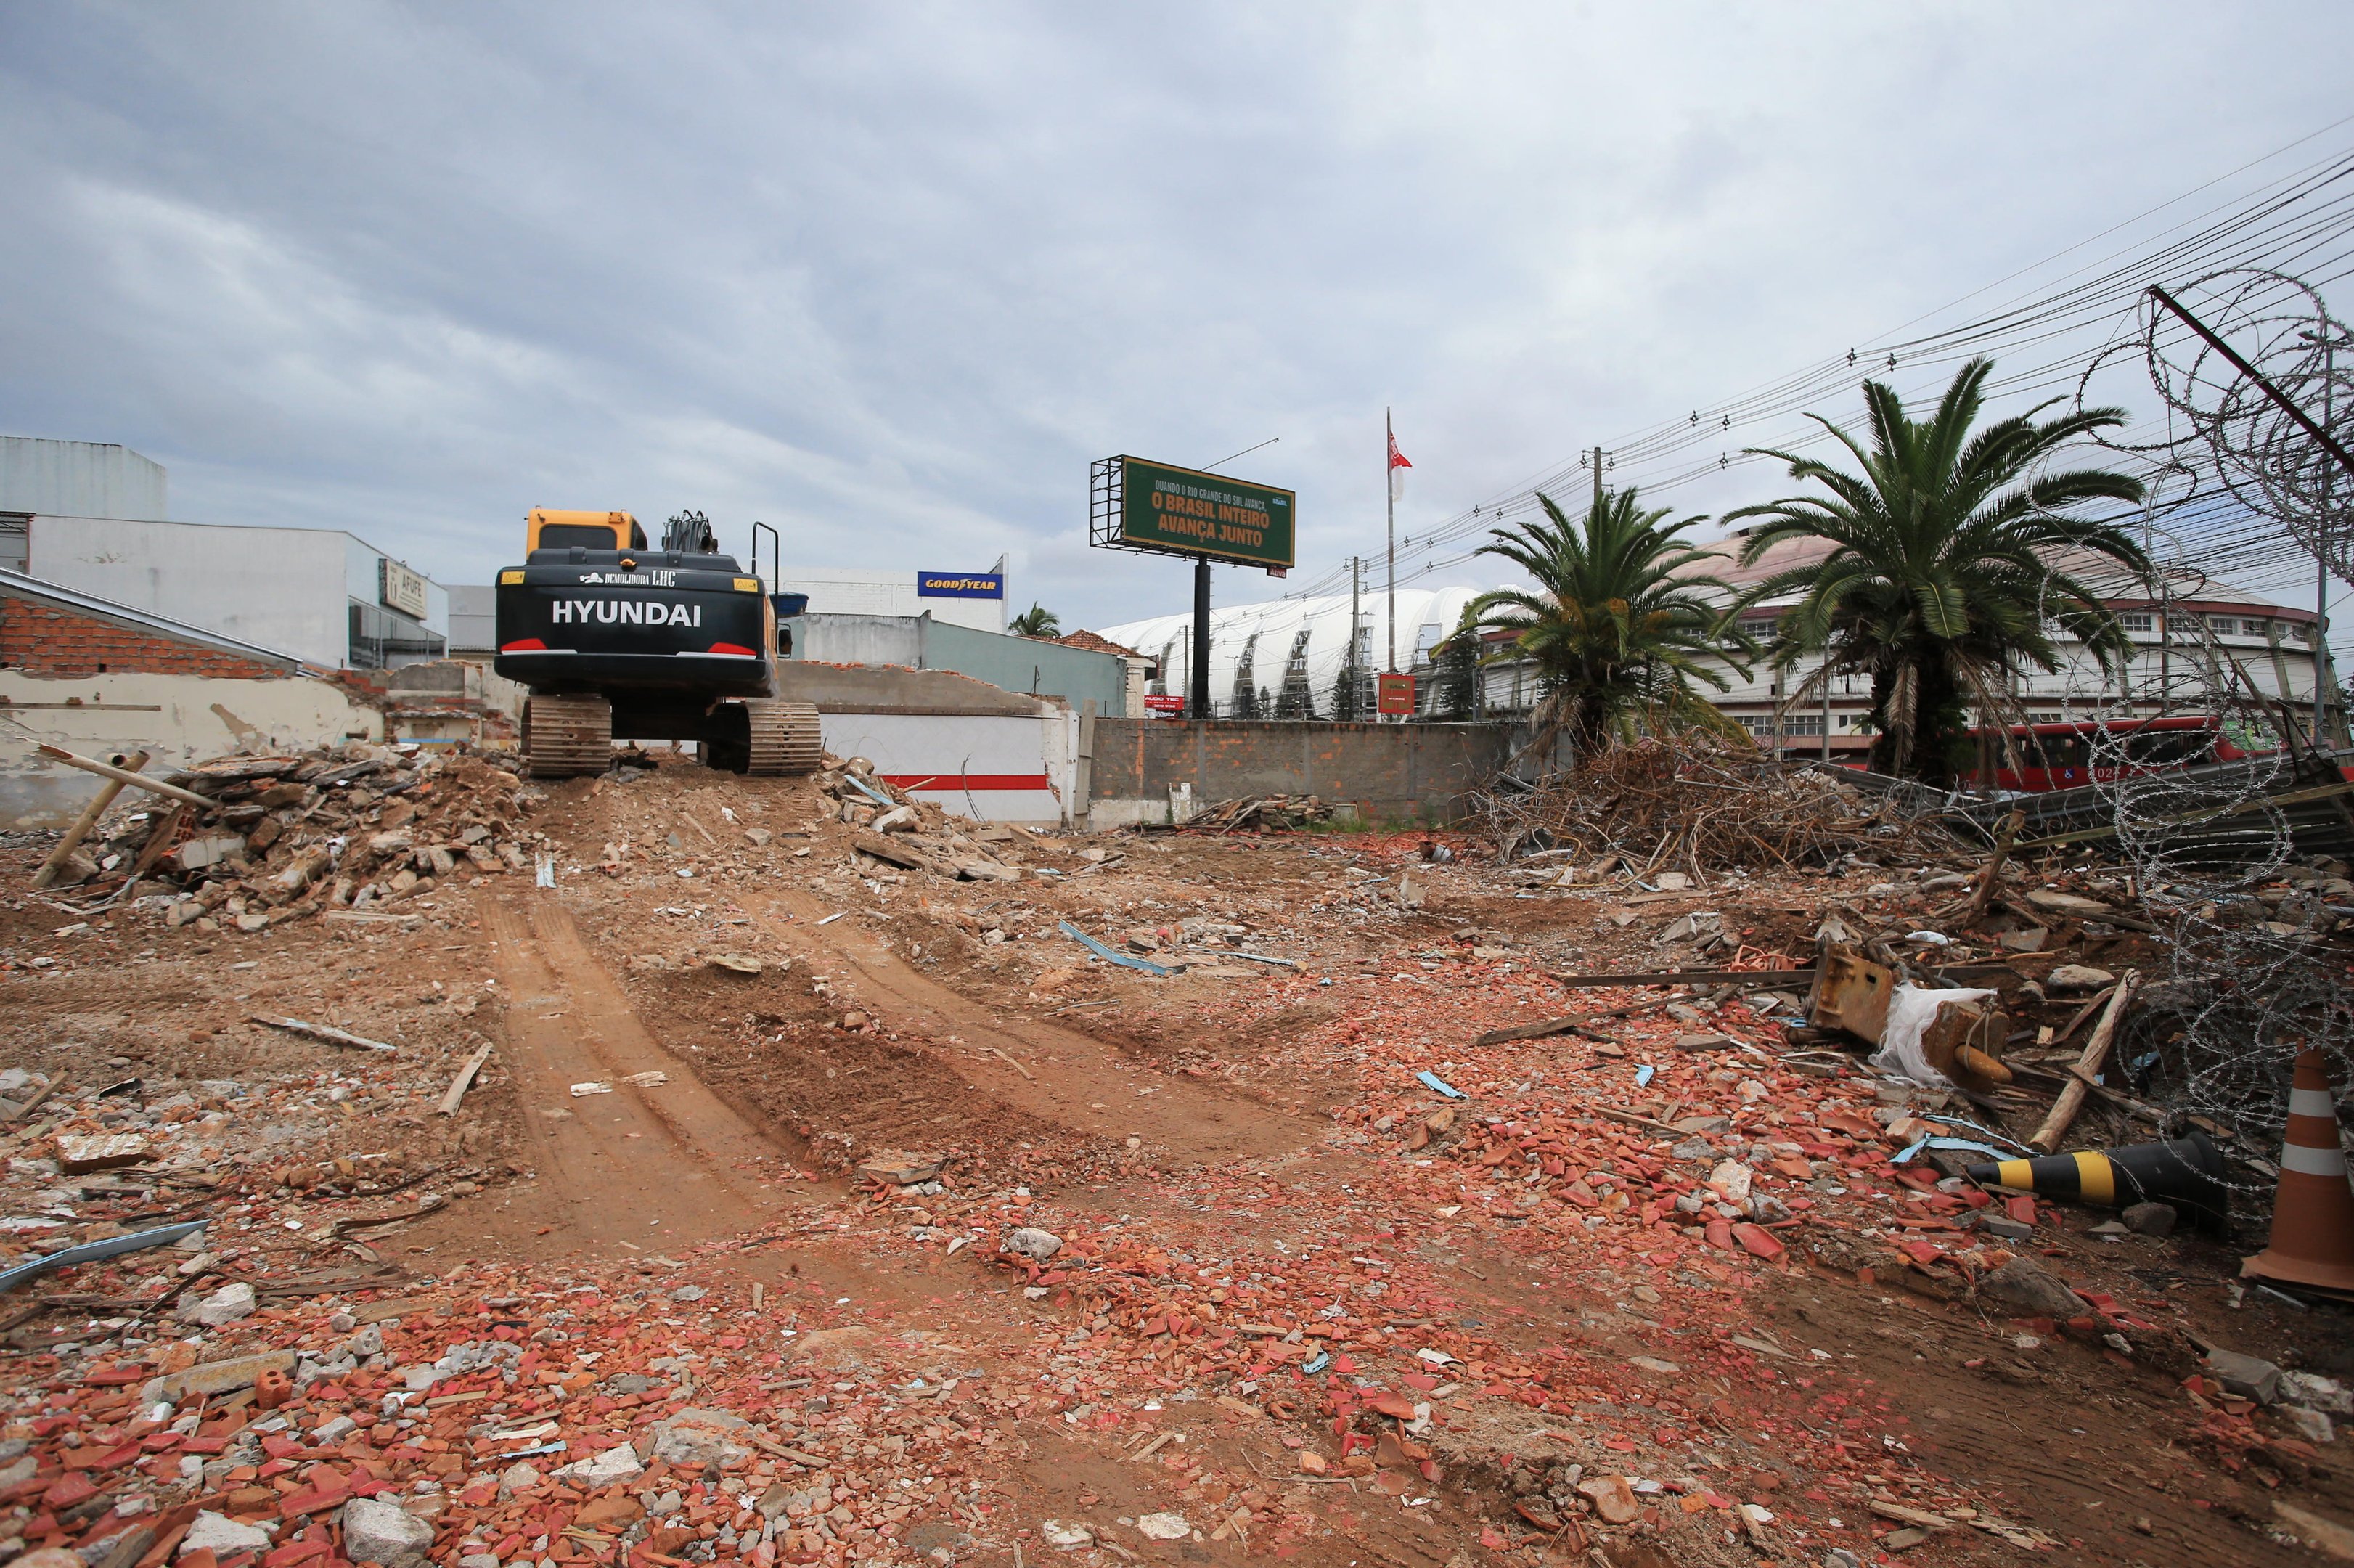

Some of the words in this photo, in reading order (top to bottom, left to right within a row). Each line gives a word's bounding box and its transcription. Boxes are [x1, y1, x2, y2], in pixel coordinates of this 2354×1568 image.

[1155, 480, 1180, 494] QUANDO
[1182, 485, 1186, 495] O
[1188, 486, 1198, 497] RIO
[1199, 489, 1222, 503] GRANDE
[1223, 493, 1232, 504] DO
[1233, 495, 1243, 507] SUL
[1151, 491, 1163, 510] O
[1166, 494, 1216, 519] BRASIL
[1219, 504, 1270, 529] INTEIRO
[1158, 513, 1217, 543] AVANÇA
[1218, 524, 1263, 547] JUNTO
[605, 573, 650, 585] DEMOLIDORA
[652, 570, 676, 587] LHC
[552, 600, 701, 628] HYUNDAI
